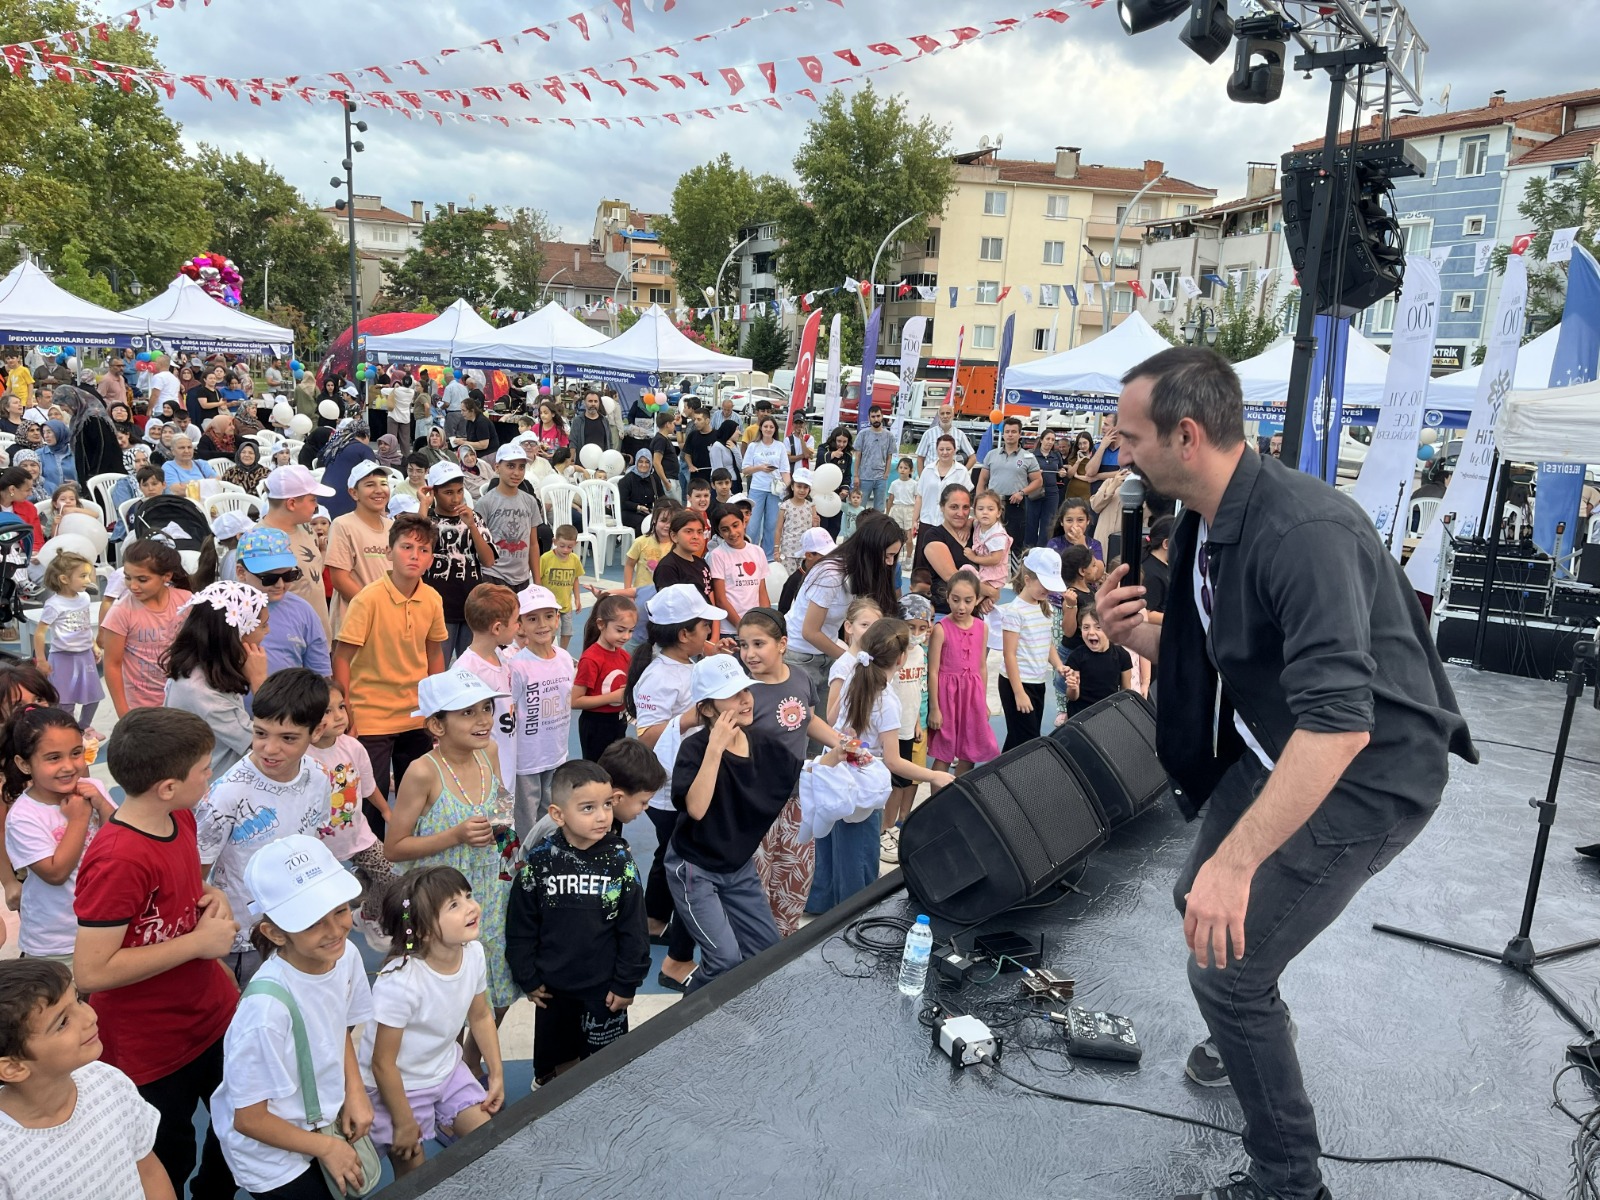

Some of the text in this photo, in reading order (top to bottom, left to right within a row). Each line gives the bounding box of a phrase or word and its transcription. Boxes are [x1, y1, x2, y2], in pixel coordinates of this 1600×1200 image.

[9, 335, 115, 345] İPEKYOLU KADINLARI DERNEĞİ
[904, 338, 920, 353] 700
[1433, 347, 1458, 357] KTRİK
[1064, 395, 1105, 405] BÜYÜKŞEHİR
[1075, 404, 1092, 412] ŞUBE
[1093, 404, 1118, 412] MÜDÜR
[1342, 408, 1363, 416] İYESİ
[1247, 412, 1275, 421] KÜLTÜR
[542, 685, 559, 694] JEANS
[525, 682, 540, 736] DESIGNED
[284, 853, 309, 871] 700
[547, 874, 612, 895] STREET
